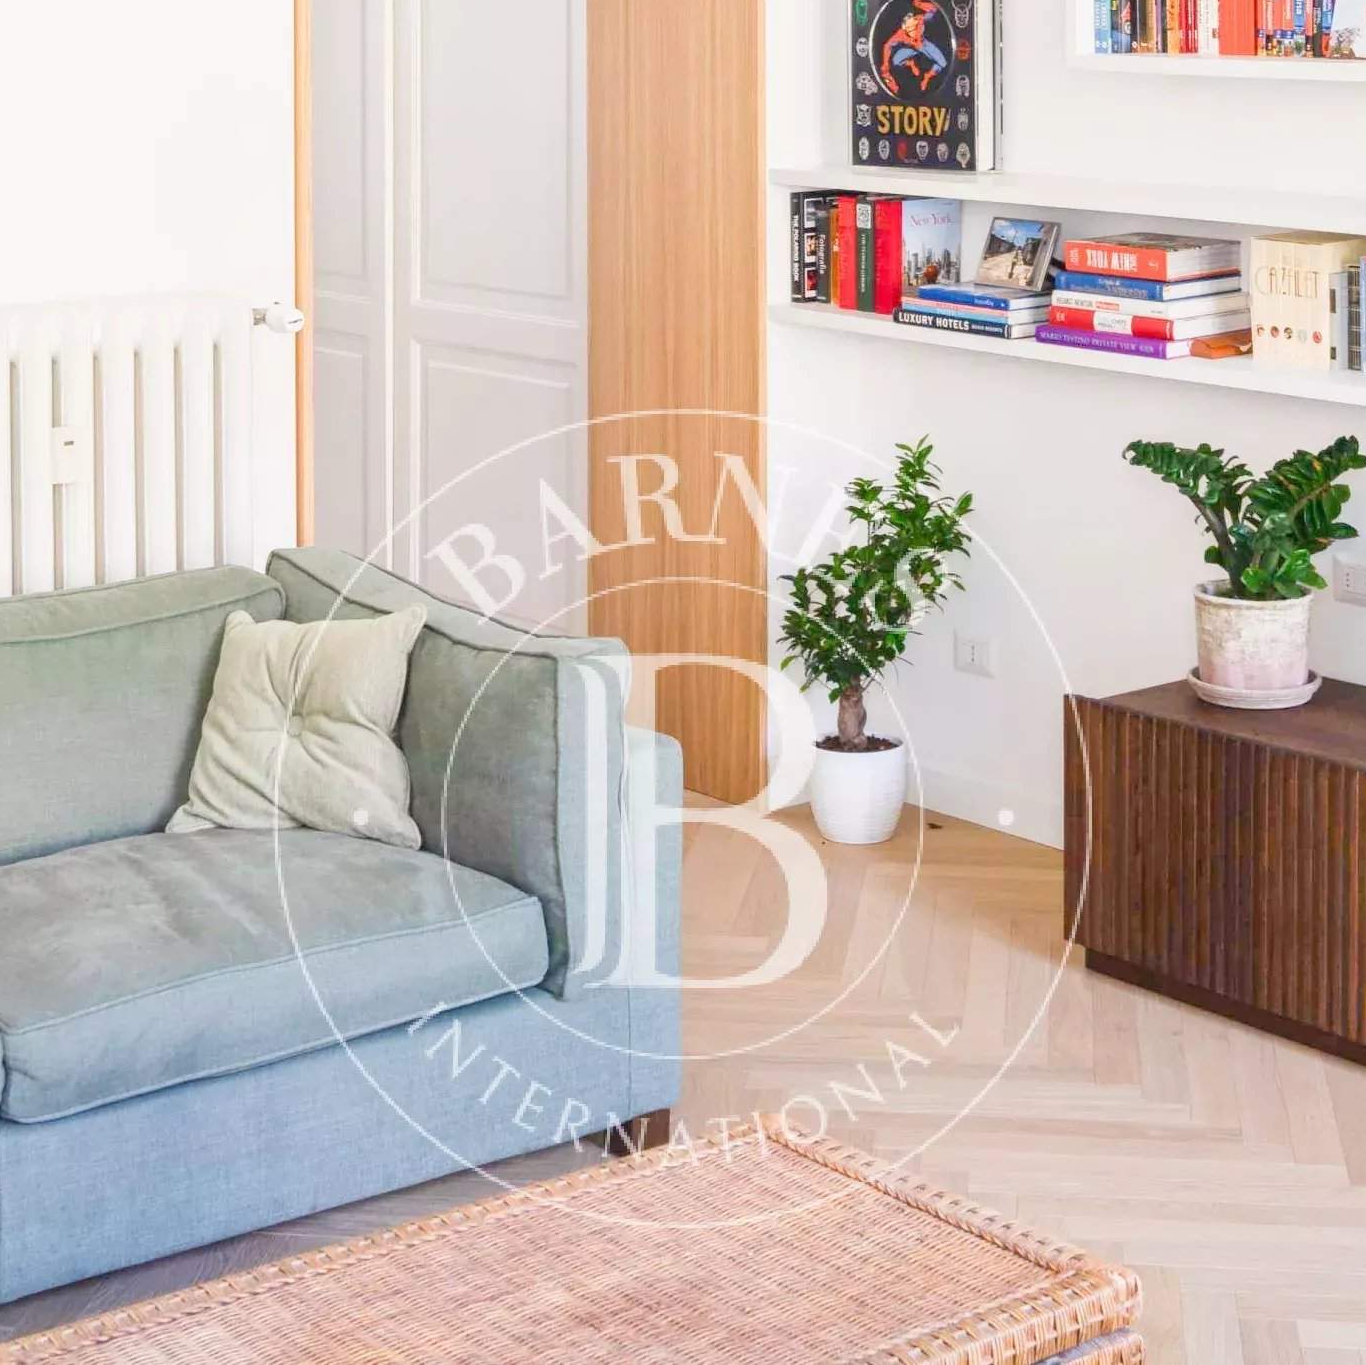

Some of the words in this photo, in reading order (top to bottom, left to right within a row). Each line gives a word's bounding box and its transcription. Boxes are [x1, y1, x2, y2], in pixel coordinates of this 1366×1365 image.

[876, 105, 947, 137] STORY
[910, 214, 928, 227] New
[932, 212, 952, 226] York
[818, 234, 826, 274] Fotografia
[898, 312, 933, 325] LUXURY
[935, 318, 969, 330] HOTELS
